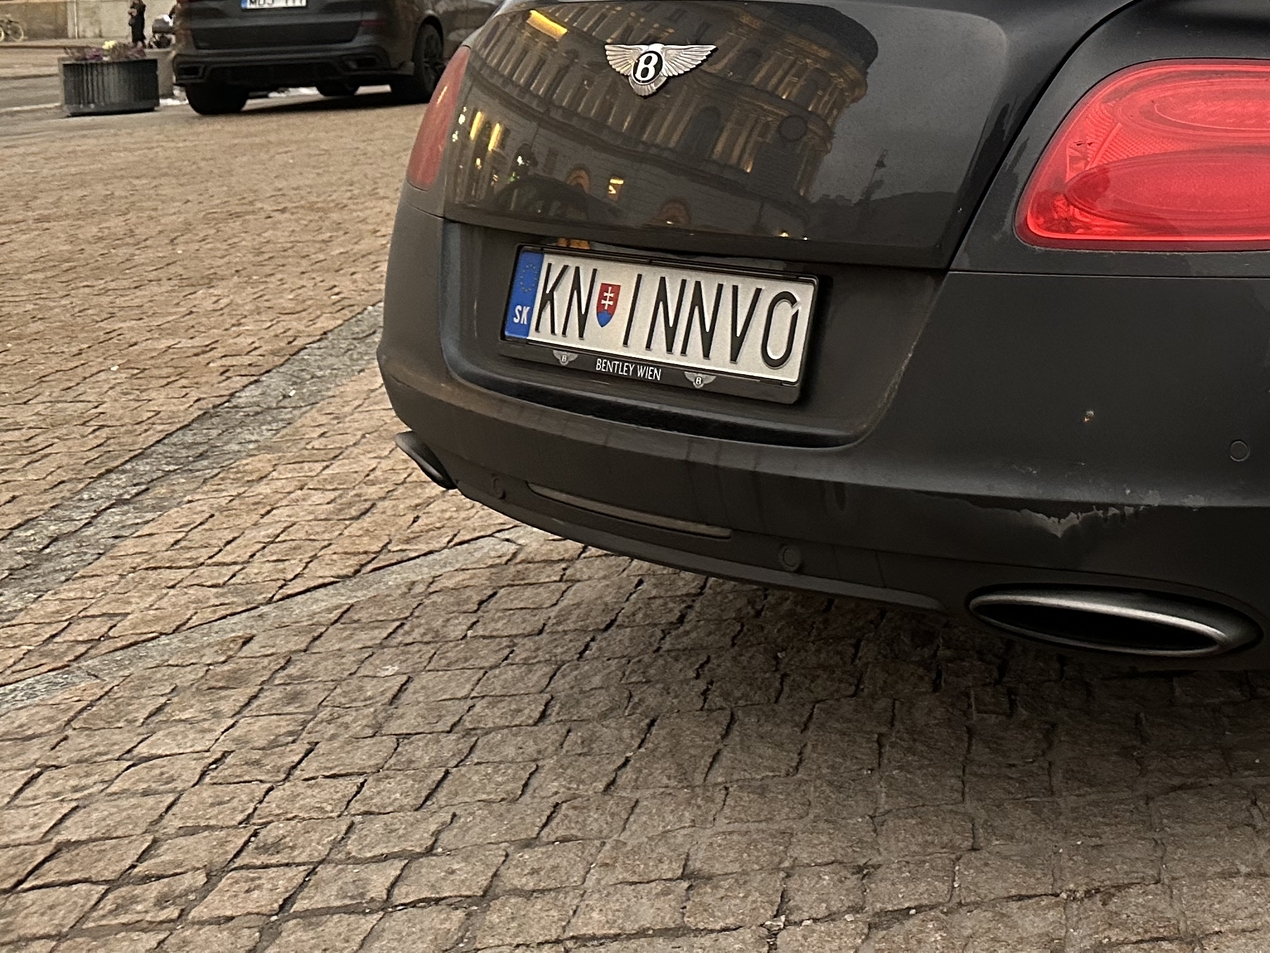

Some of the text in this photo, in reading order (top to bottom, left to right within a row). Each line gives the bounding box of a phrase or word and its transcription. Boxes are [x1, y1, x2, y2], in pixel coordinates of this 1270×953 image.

[513, 304, 531, 326] SK
[534, 261, 800, 371] KN INNVO
[595, 358, 662, 381] BENTLEY WIEN
